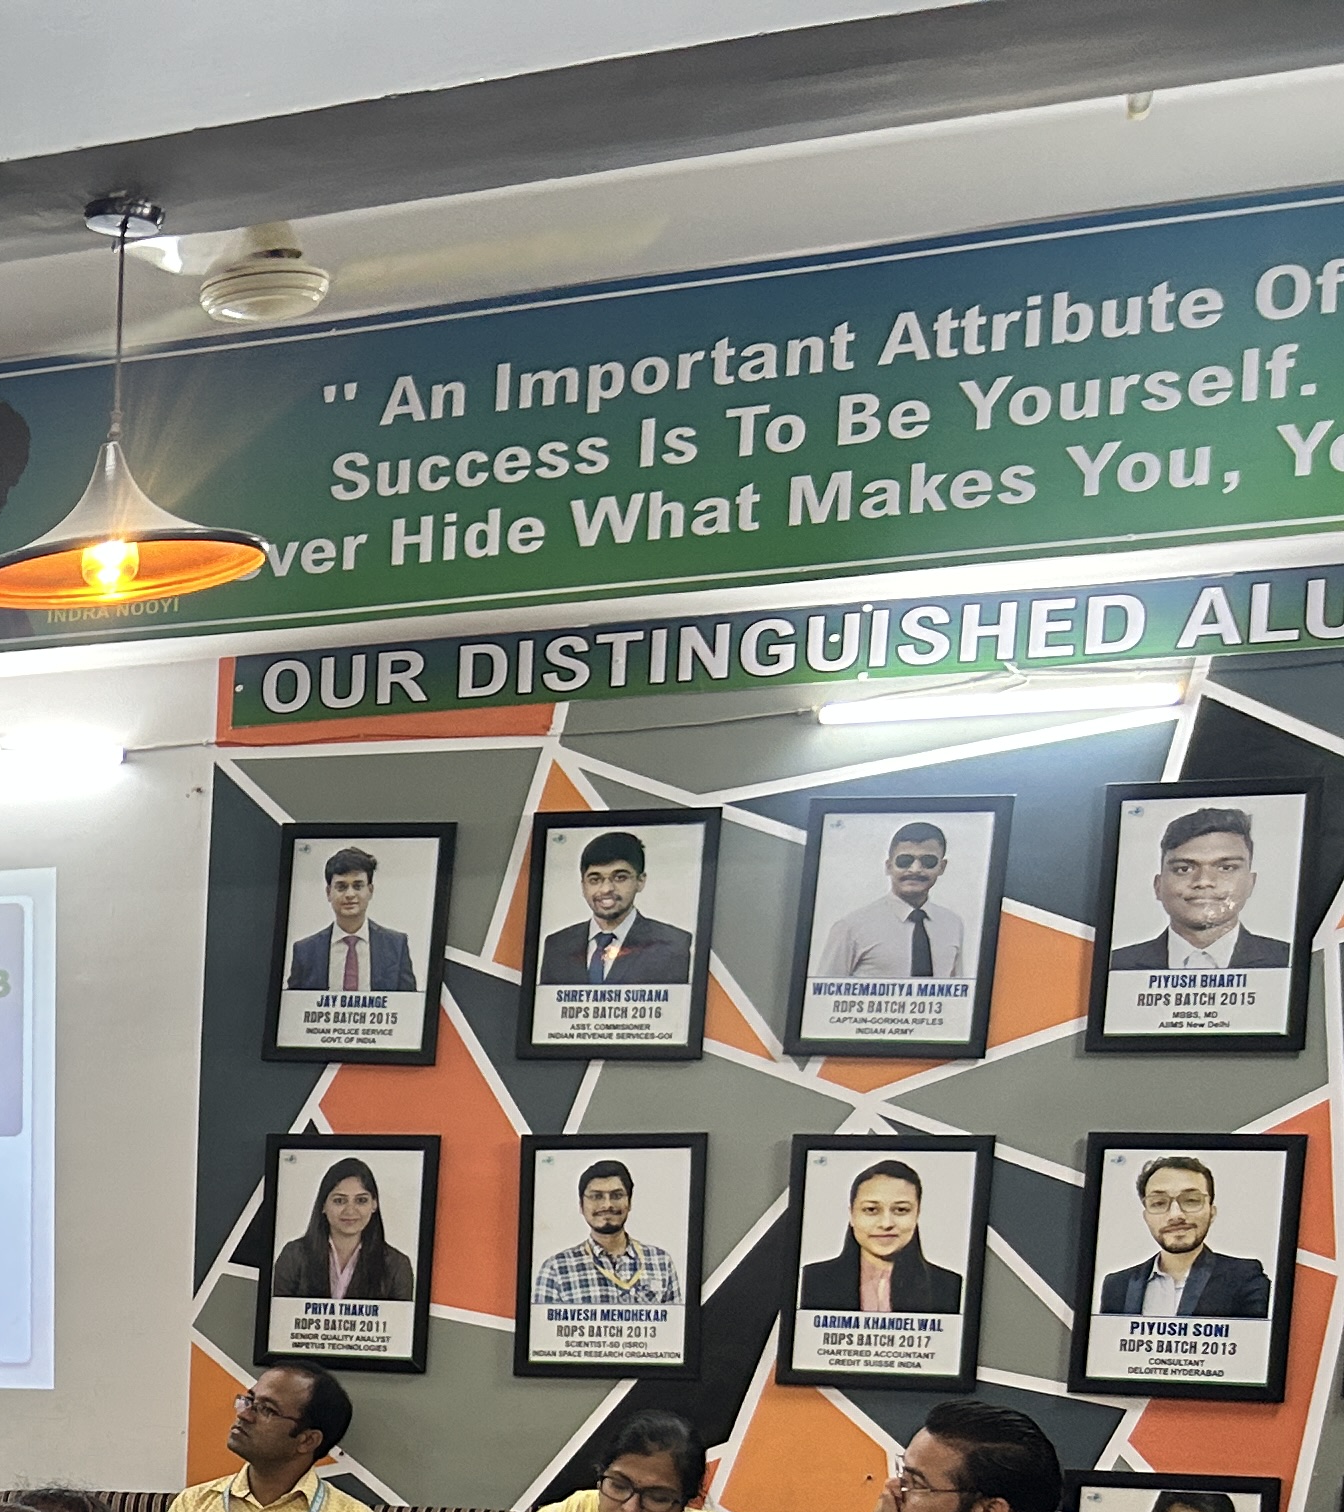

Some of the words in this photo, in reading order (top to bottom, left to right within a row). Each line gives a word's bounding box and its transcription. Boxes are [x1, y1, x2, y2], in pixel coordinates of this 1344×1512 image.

[379, 375, 467, 426] An
[494, 321, 856, 413] Important
[877, 280, 1224, 366] Attribute
[1255, 258, 1344, 320] Of
[330, 434, 611, 501] Success
[639, 417, 698, 468] Is
[725, 404, 807, 457] To
[837, 393, 931, 446] Be
[958, 343, 1317, 431] Yourself.
[237, 532, 368, 581] ver
[391, 508, 546, 566] Hide
[569, 483, 760, 547] What
[788, 461, 1037, 527] Makes
[1065, 440, 1241, 497] You,
[46, 607, 110, 623] INDRA
[116, 597, 180, 618] NOOYI
[260, 648, 430, 716] OUR
[455, 592, 1145, 700] DISTINGUISHED
[1148, 974, 1197, 988] PIYUSH
[1200, 973, 1248, 988] BHARTI
[556, 989, 621, 1003] SHREYANSH
[624, 989, 669, 1003] SURANA
[812, 982, 912, 997] WICKREMADITYA
[916, 983, 969, 998] MANKER
[317, 995, 339, 1008] JAY
[1137, 993, 1171, 1006] RDPS
[1174, 992, 1216, 1006] BATCH
[1220, 991, 1256, 1006] 2015
[561, 1006, 590, 1019] RDPS
[592, 1006, 628, 1019] BATCH
[631, 1006, 662, 1019] 2016
[832, 1000, 865, 1013] RDPS
[867, 1001, 906, 1014] BATCH
[910, 1001, 943, 1014] 2013
[303, 1011, 331, 1024] RDPS
[333, 1012, 366, 1025] BATCH
[369, 1012, 398, 1025] 2015
[304, 1302, 336, 1316] PRIYA
[339, 1303, 379, 1317] THAKUR
[547, 1308, 597, 1322] BHAVESH
[600, 1308, 668, 1322] MENDHEKAR
[294, 1318, 321, 1330] RDPS
[323, 1318, 356, 1332] BATCH
[359, 1320, 387, 1333] 2011
[813, 1315, 860, 1329] GARIMA
[1129, 1321, 1188, 1337] PIYUSH
[1192, 1323, 1229, 1337] SONI
[556, 1325, 585, 1338] RDPS
[588, 1325, 623, 1338] BATCH
[627, 1326, 657, 1338] 2013
[823, 1332, 853, 1346] RDPS
[856, 1333, 895, 1348] BATCH
[898, 1334, 932, 1348] 2017
[1119, 1339, 1153, 1353] RDPS
[1156, 1340, 1197, 1355] BATCH
[1201, 1341, 1237, 1356] 2013
[1148, 1357, 1205, 1367] CONSULTANT
